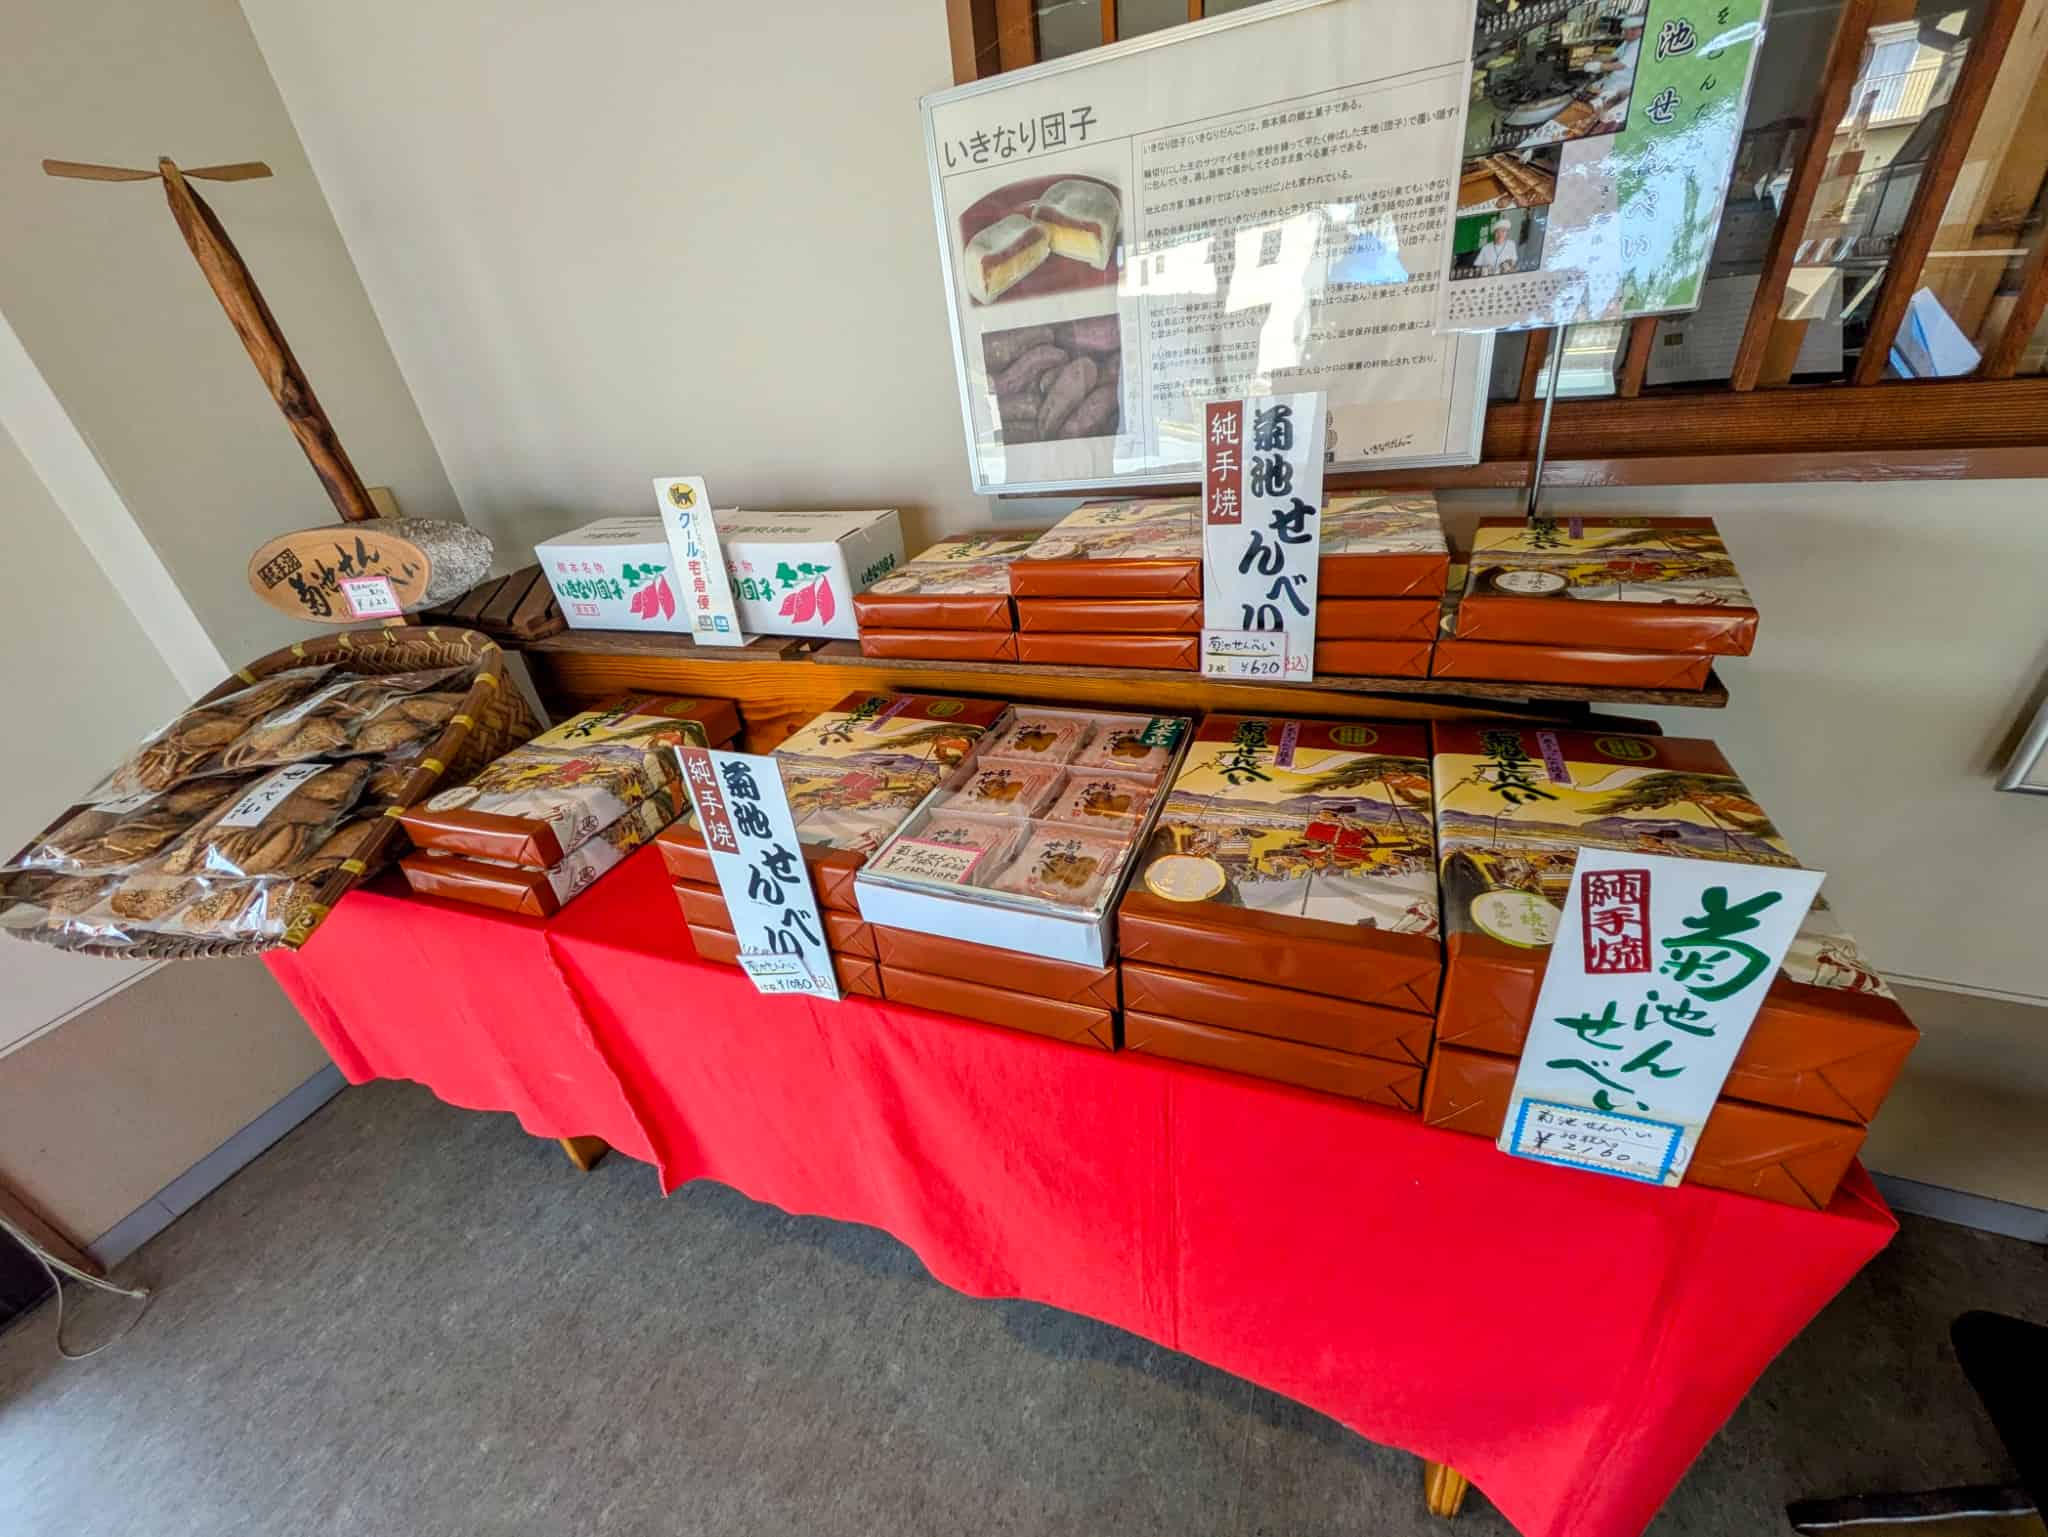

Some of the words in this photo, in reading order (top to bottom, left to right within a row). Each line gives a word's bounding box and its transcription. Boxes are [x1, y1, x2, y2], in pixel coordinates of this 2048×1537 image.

[944, 106, 1097, 168] いきなり団子
[1210, 412, 1240, 518] 純手焼
[678, 512, 710, 610] クール宅急便
[1238, 403, 1317, 633] 菊池せんべい
[556, 578, 625, 601] いきなり団子
[1240, 660, 1281, 674] ¥620
[687, 756, 737, 848] 純手焼
[719, 760, 821, 961] 菊池せんべい
[1586, 874, 1644, 971] 純手焼
[1545, 885, 1783, 1112] 菊池せんべい
[1536, 1110, 1654, 1138] 菊池せんべい
